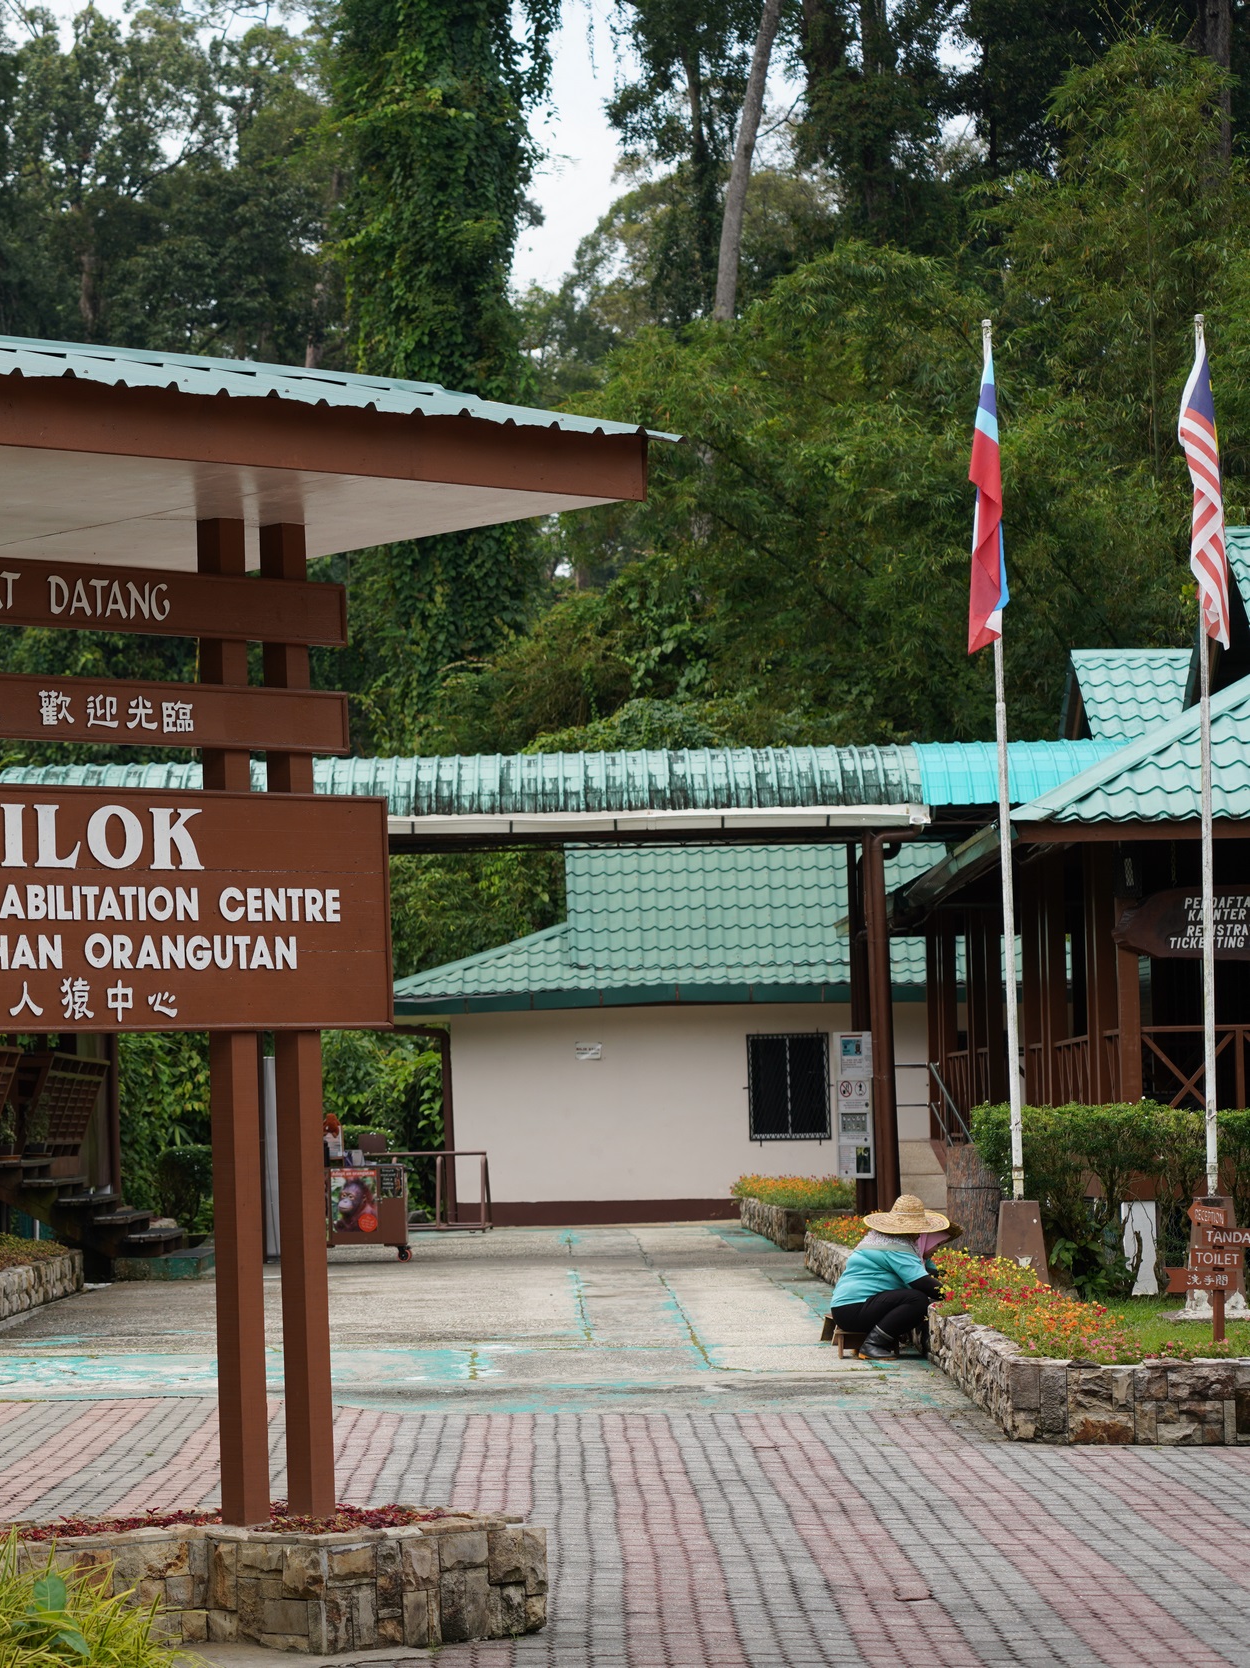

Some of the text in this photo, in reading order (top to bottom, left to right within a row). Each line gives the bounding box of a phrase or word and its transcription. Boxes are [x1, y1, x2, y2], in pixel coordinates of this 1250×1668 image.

[47, 575, 171, 622] DATANG
[37, 688, 195, 734] 歡迎光臨
[218, 886, 342, 923] CENTRE
[1188, 909, 1247, 921] KANTER
[84, 933, 299, 972] ORANGUTAN
[1170, 937, 1245, 949] TICKETING
[1194, 1208, 1224, 1225] RECEPTION
[1195, 1252, 1240, 1265] TOILET
